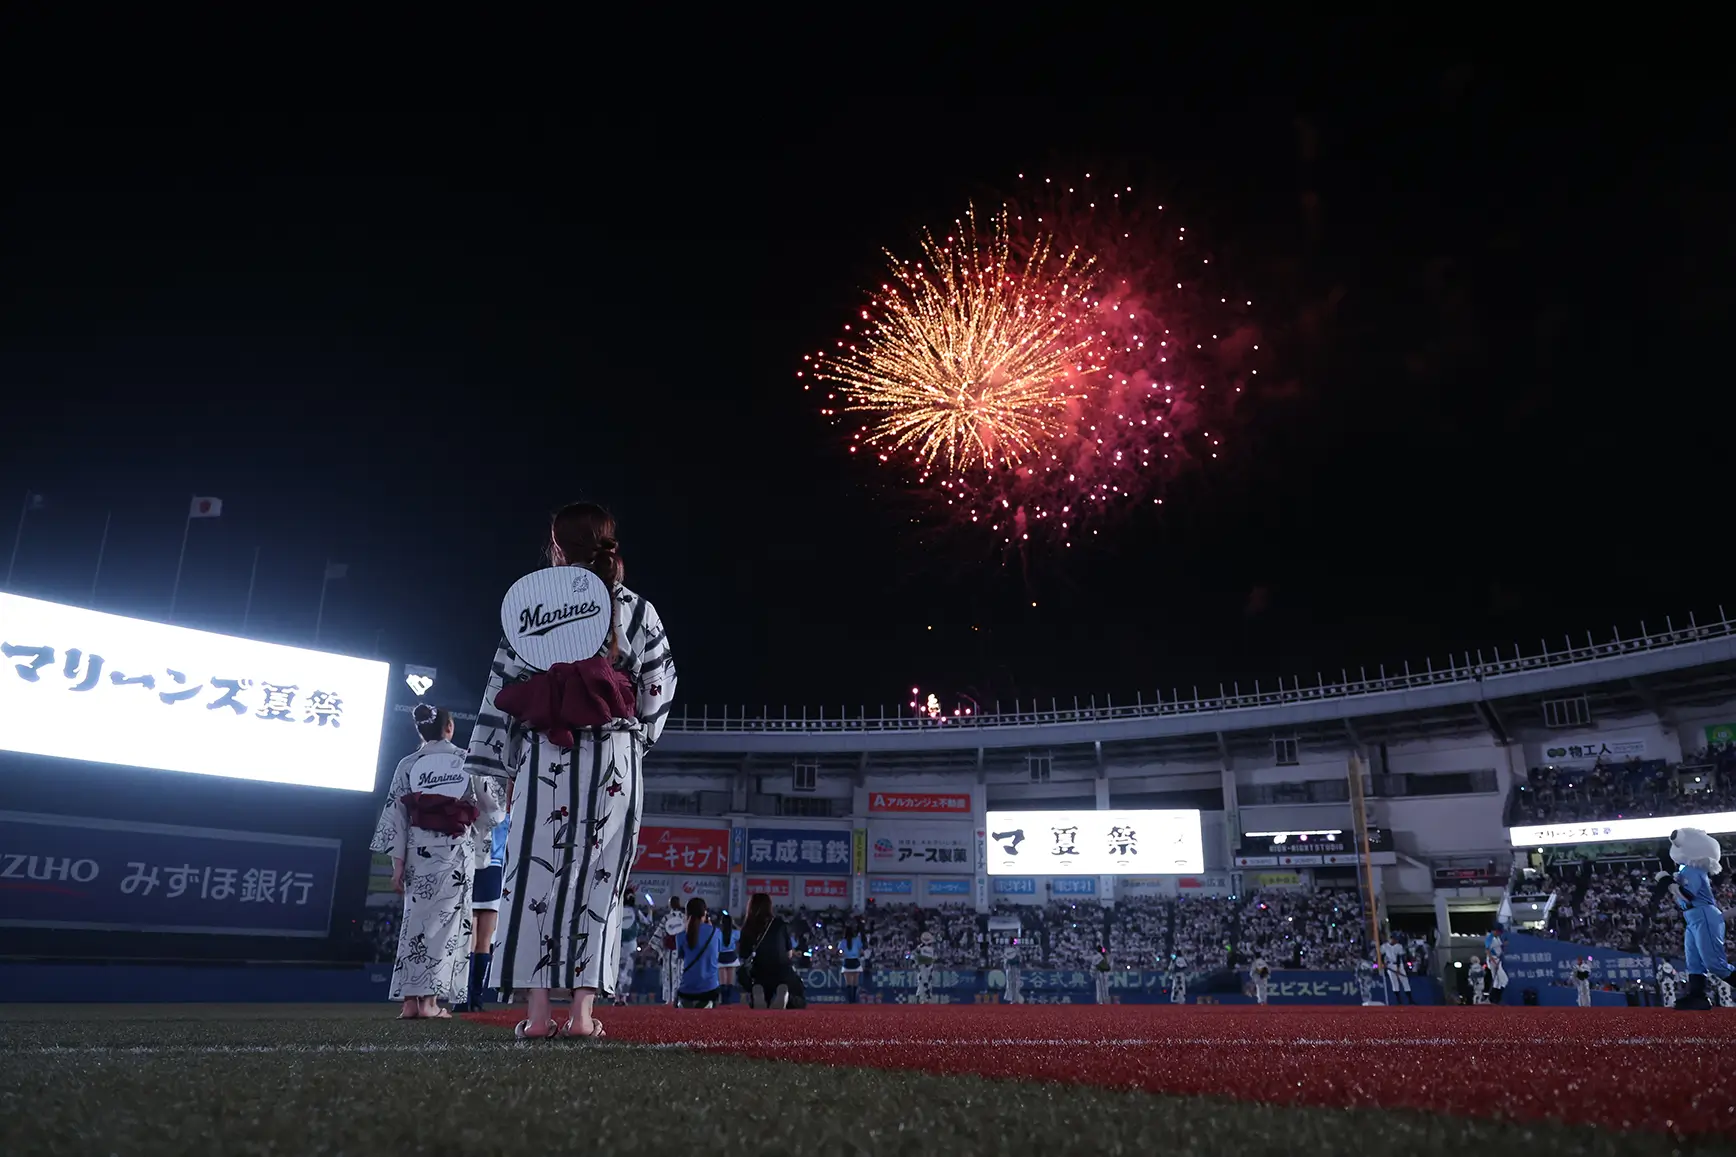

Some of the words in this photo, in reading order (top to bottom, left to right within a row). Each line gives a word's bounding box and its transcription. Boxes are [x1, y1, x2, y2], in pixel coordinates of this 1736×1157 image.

[518, 601, 600, 638] Marines
[1, 641, 344, 728] マリーンズ夏祭
[418, 771, 464, 789] Marines
[633, 844, 727, 869] アーキセプト
[750, 838, 849, 863] 京成電鉄
[898, 848, 968, 863] アース製薬
[0, 853, 99, 882] ZUHO
[120, 861, 314, 904] みずほ銀行
[797, 968, 842, 988] EON
